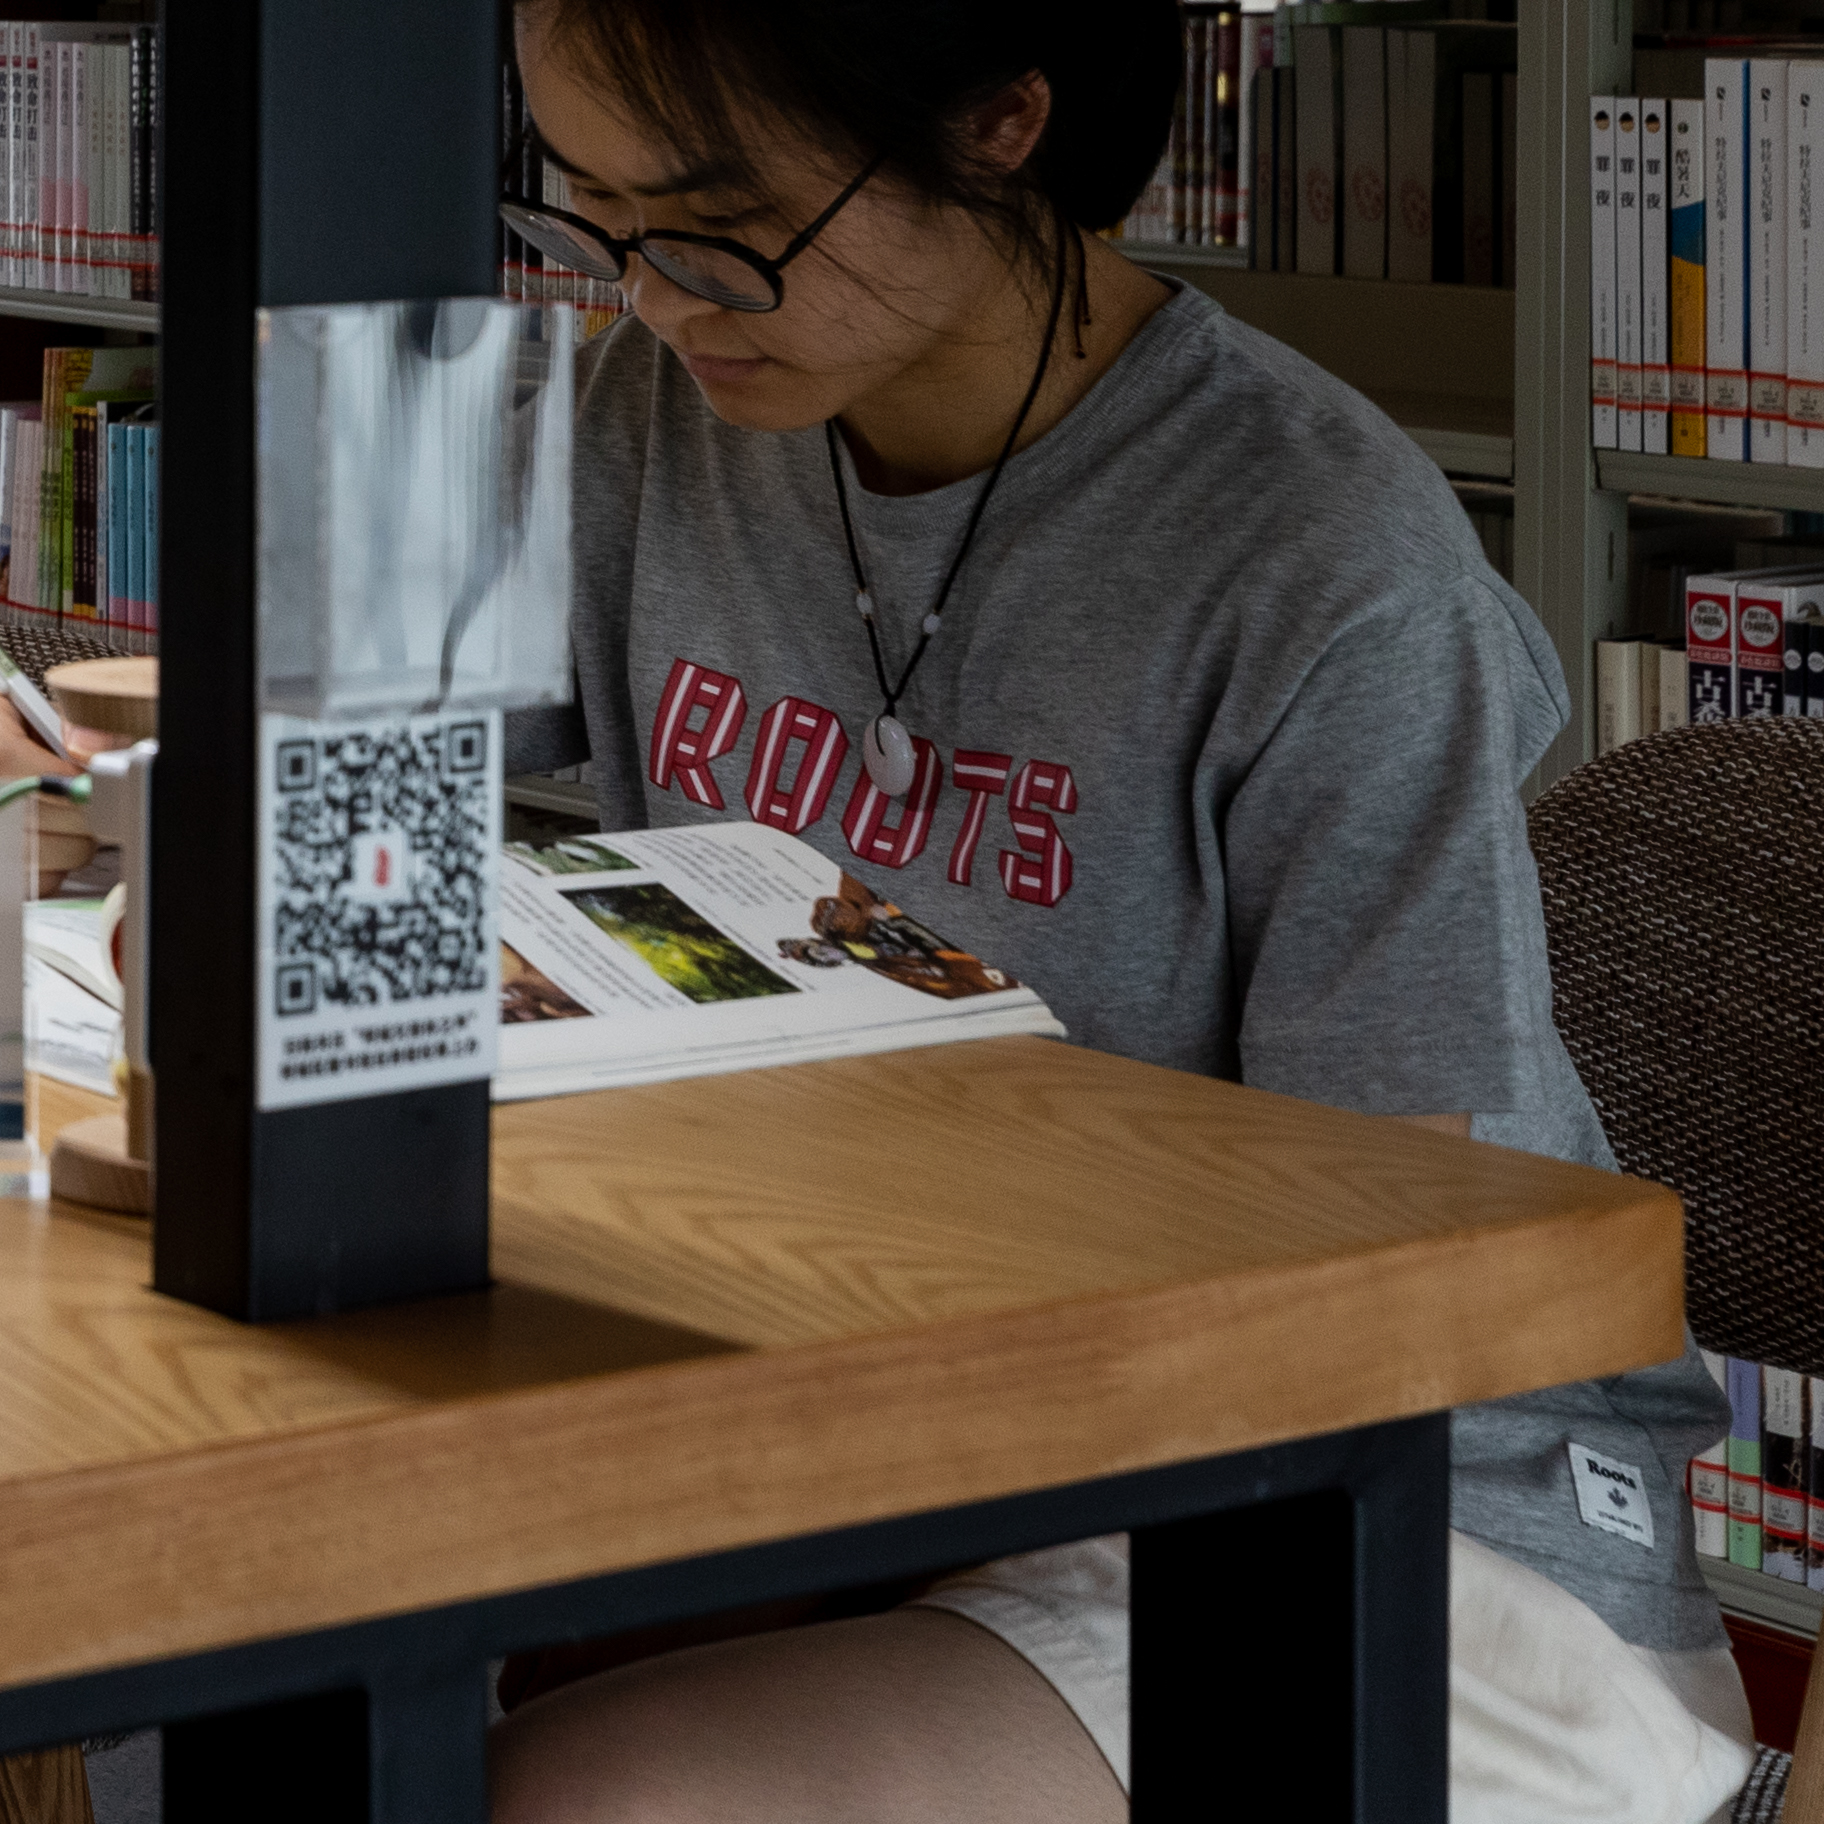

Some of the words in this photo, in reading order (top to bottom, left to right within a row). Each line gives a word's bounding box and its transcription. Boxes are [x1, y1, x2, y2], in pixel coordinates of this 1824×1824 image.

[1675, 148, 1691, 200] 酷暑天
[648, 657, 1079, 909] ROOTS
[1585, 1458, 1637, 1490] Roots
